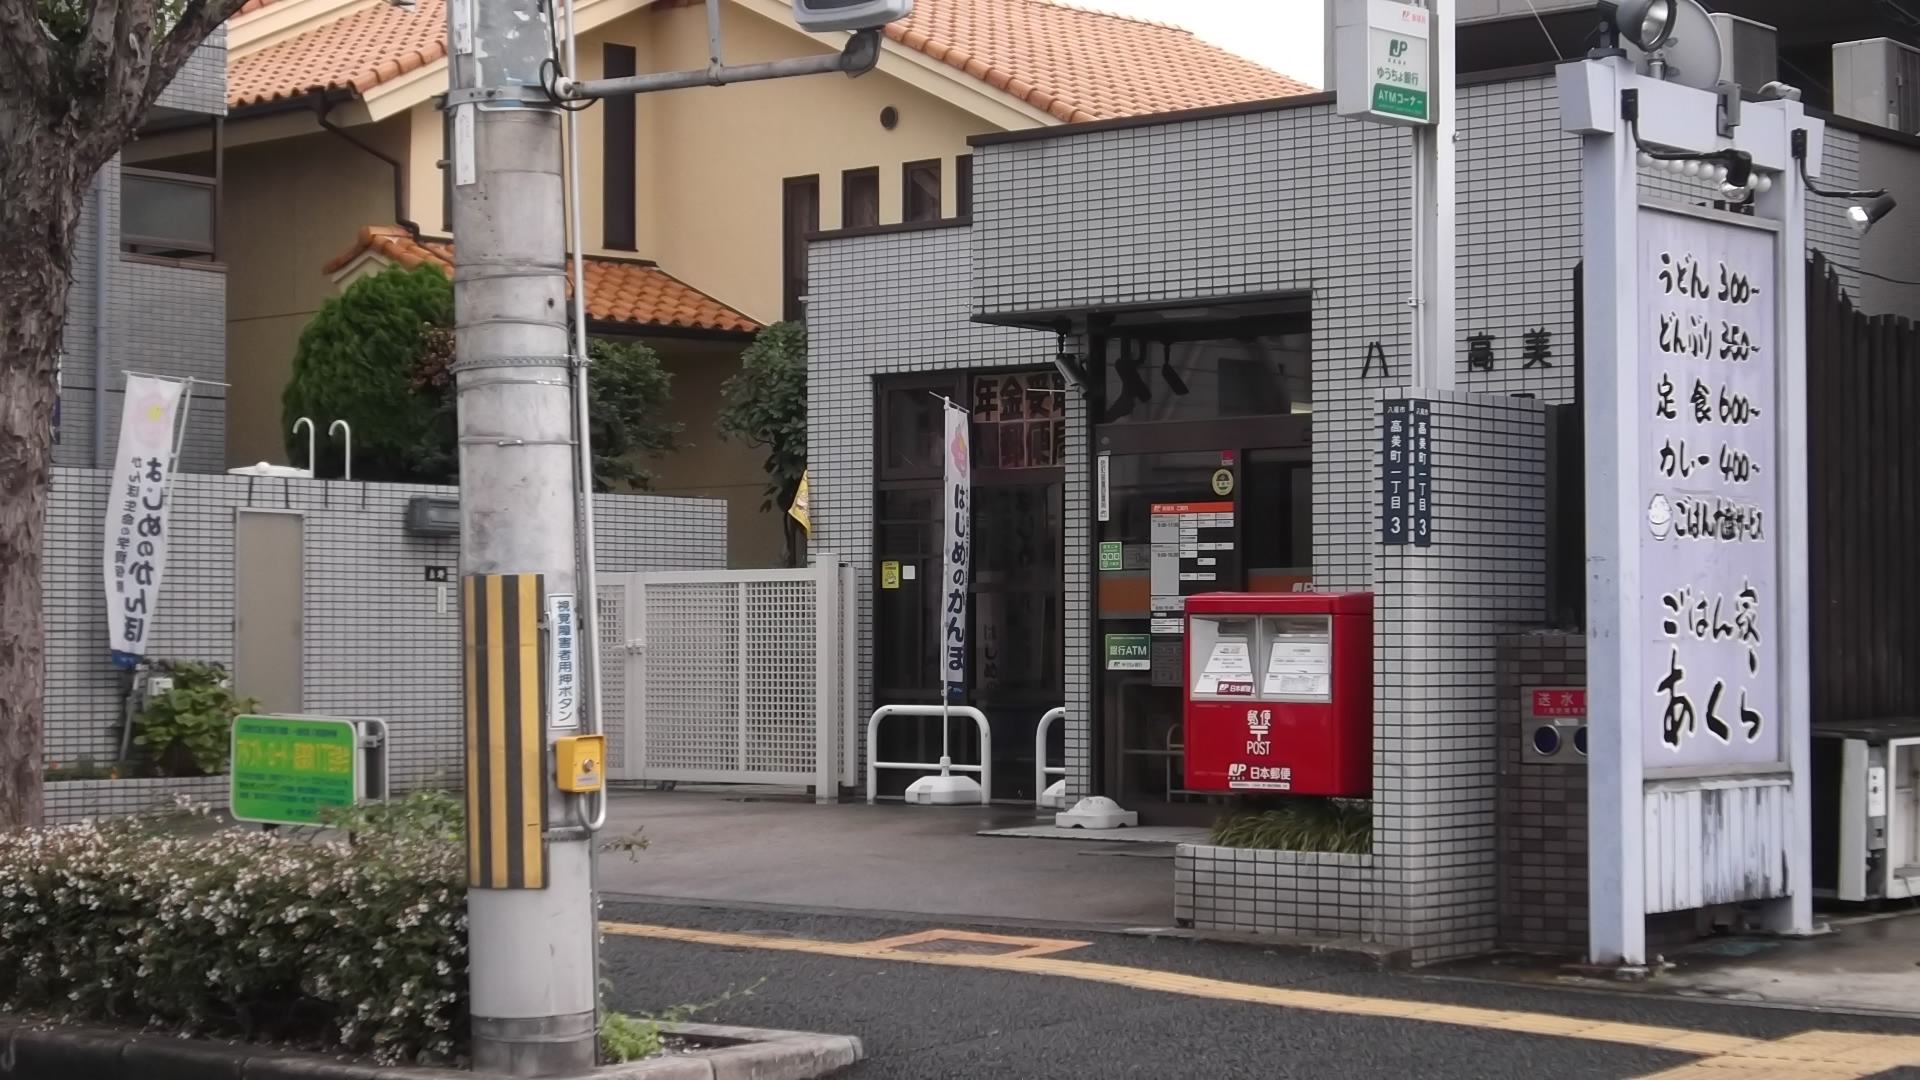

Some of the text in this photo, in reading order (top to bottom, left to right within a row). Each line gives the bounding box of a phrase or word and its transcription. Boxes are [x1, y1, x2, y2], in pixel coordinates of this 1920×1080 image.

[1389, 39, 1408, 58] JP
[1376, 66, 1419, 86] ゆうちょ銀行
[1378, 89, 1423, 106] ATMコーナー
[1658, 252, 1710, 299] うどん
[1659, 311, 1713, 360] どんぶり
[1387, 406, 1406, 414] 八尾市
[948, 483, 966, 672] はじめのかんぽ
[1662, 578, 1761, 643] ごはん家
[1109, 645, 1147, 656] 銀行ATM
[557, 600, 573, 723] 視覚障害者用押ボタン
[1230, 684, 1252, 693] 日本郵便
[1656, 647, 1762, 747] あくら
[1537, 691, 1588, 707] 送水
[1247, 709, 1271, 727] 郵便
[1246, 740, 1271, 755] POST
[1228, 763, 1291, 781] JP 日本郵便
